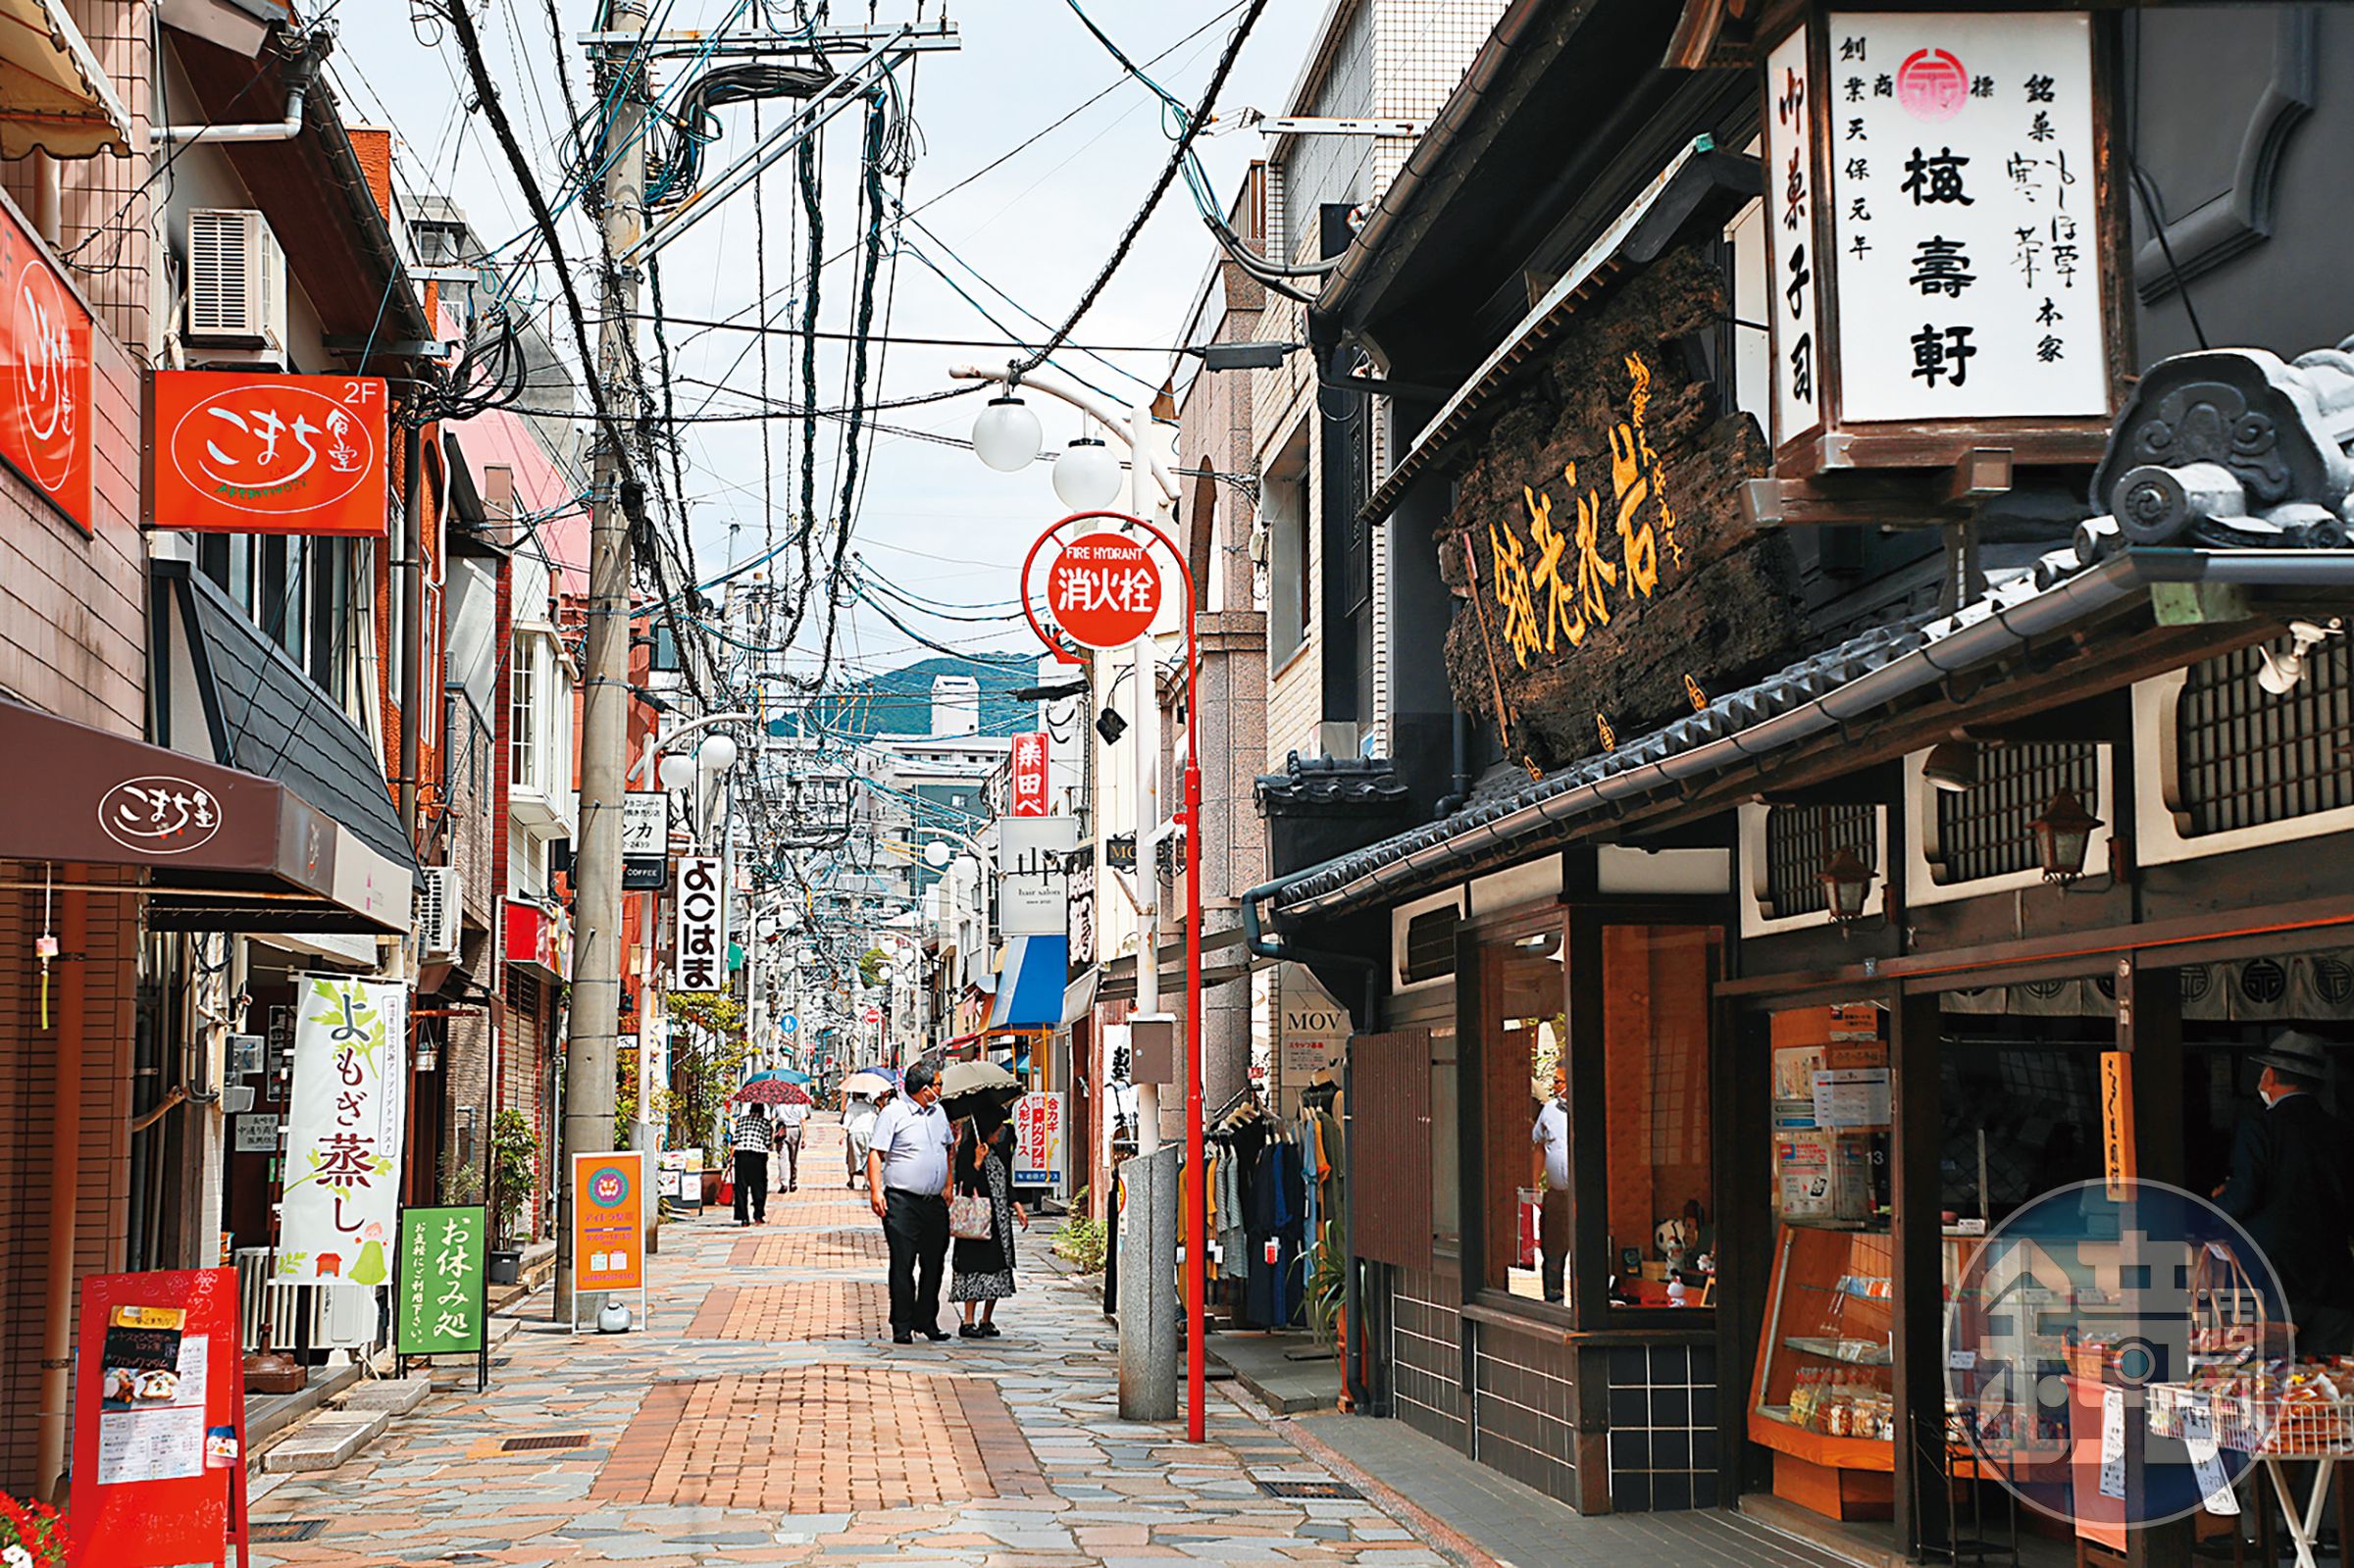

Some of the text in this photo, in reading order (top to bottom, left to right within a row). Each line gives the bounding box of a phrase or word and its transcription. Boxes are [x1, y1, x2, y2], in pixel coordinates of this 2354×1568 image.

[1873, 74, 1994, 99] 商 標
[1839, 35, 1872, 262] 創業天保元年
[2035, 297, 2065, 363] 本家
[344, 381, 378, 404] 2F
[198, 406, 323, 488] こまち
[1065, 546, 1146, 562] FIRE HYDRANT
[1057, 567, 1155, 613] 消火栓
[114, 785, 193, 836] こまち
[627, 868, 658, 877] COFFEE
[1018, 887, 1038, 896] hair
[683, 860, 717, 988] よこはま
[315, 993, 376, 1234] よもぎ蒸し
[1018, 1097, 1031, 1157] 人形ケース
[1866, 1150, 1884, 1166] 13
[410, 1222, 427, 1344] お気軽にご利用下さい。
[434, 1217, 474, 1339] お休み処
